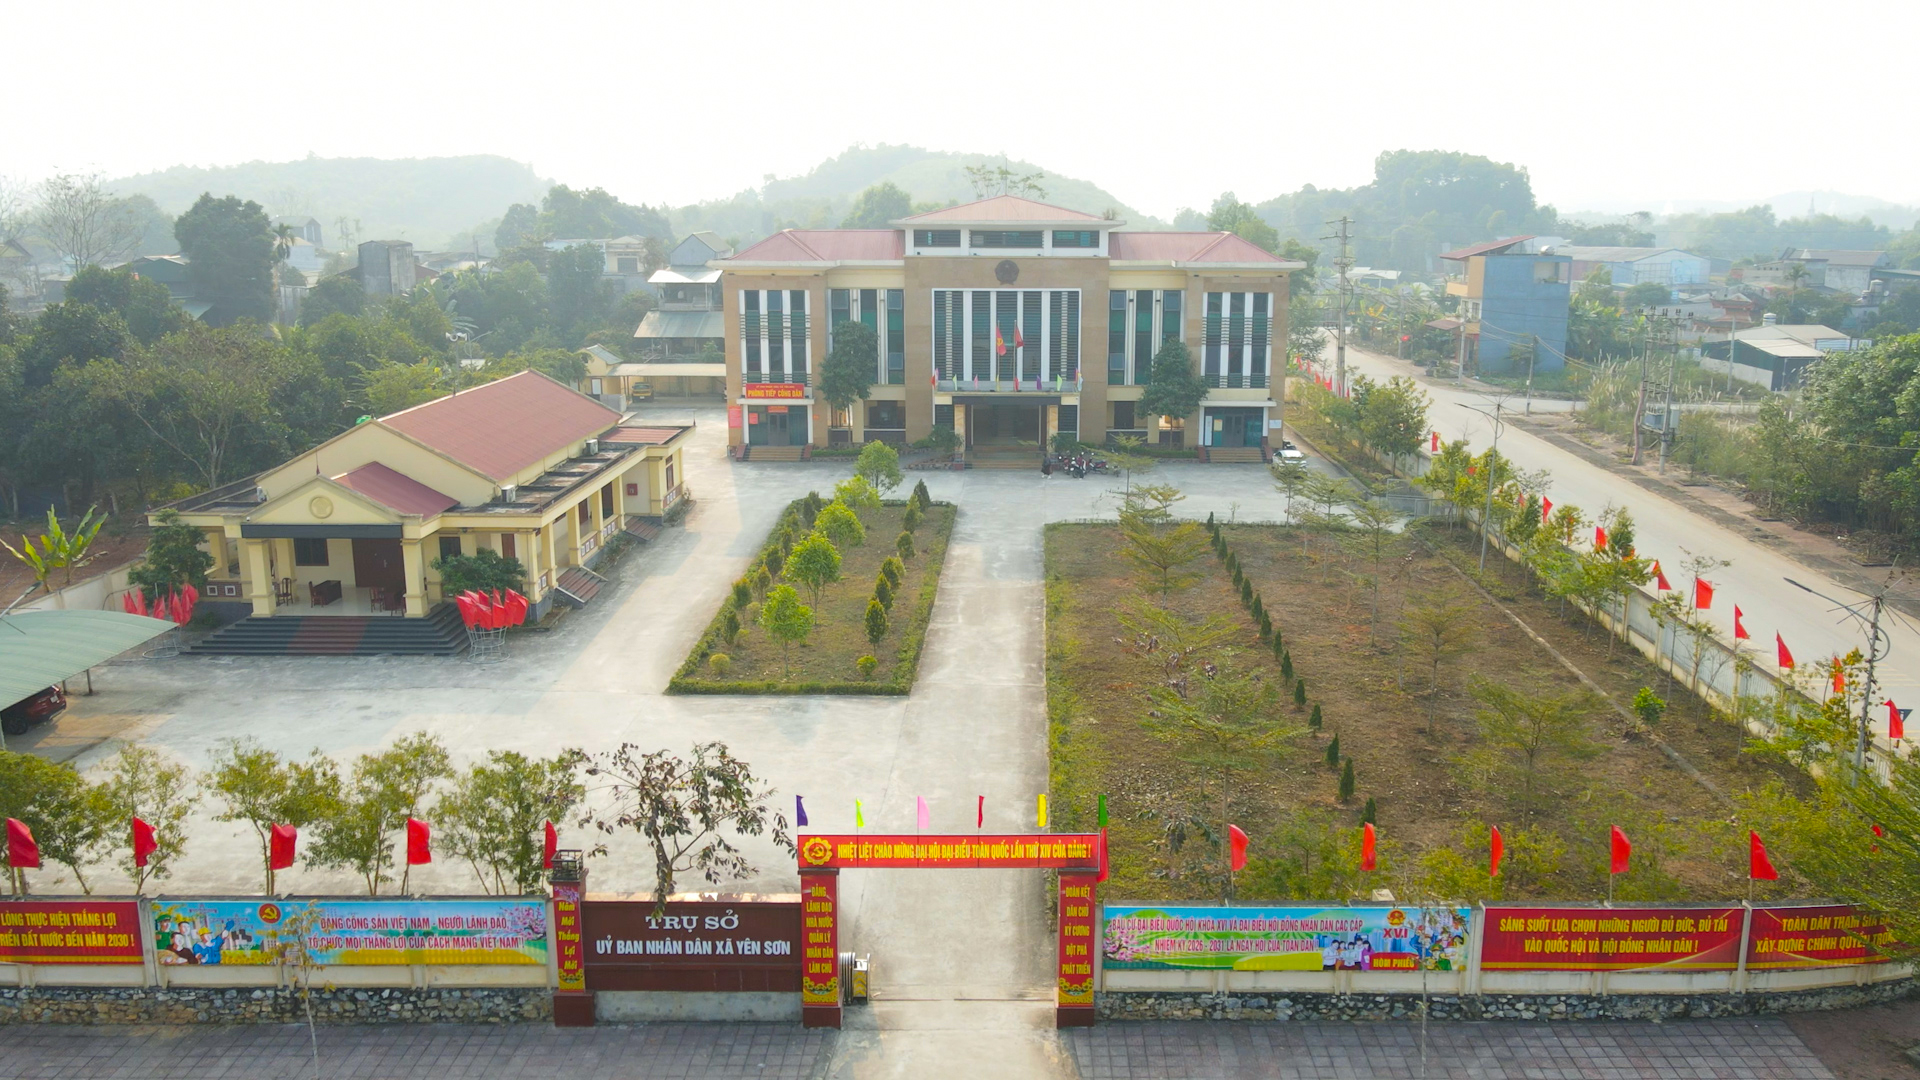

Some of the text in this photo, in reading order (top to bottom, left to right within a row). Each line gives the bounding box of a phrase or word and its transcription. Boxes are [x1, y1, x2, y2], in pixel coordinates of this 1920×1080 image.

[838, 841, 857, 861] NHIỆT
[858, 841, 872, 861] LIỆT
[874, 842, 892, 858] CHÀO
[893, 842, 914, 858] MỪNG
[916, 844, 927, 862] ĐẠI
[929, 841, 940, 862] HỘI
[942, 844, 953, 862] ĐẠI
[955, 839, 970, 858] BIỂU
[972, 841, 990, 858] TOÀN
[991, 839, 1010, 860] QUỐC
[1025, 841, 1039, 858] THỨ
[1040, 844, 1051, 858] XIV
[1052, 839, 1066, 858] CỦA
[1068, 839, 1087, 858] ĐẢNG
[811, 883, 826, 897] ĐẢNG
[558, 902, 575, 911] Năm
[0, 909, 116, 929] LÒNG THỰC HIỆN THẮNG LỢI
[321, 914, 343, 929] ĐẢNG
[345, 914, 368, 932] CỘNG
[371, 914, 389, 929] SẢN
[391, 915, 407, 932] VIỆT
[410, 917, 430, 929] NAM
[438, 915, 464, 929] NGƯỜI
[466, 914, 488, 929] LÃNH
[561, 916, 575, 926] Mới
[645, 909, 739, 933] TRỤ SỞ
[1150, 914, 1164, 931] BIỂU
[1166, 915, 1183, 931] QUỐC
[1252, 914, 1266, 931] BIỂU
[1269, 916, 1278, 934] HỘI
[1281, 915, 1298, 931] ĐỒNG
[1301, 917, 1318, 931] NHÂN
[1320, 917, 1333, 931] DÂN
[1500, 914, 1728, 935] SÁNG SUỐT LỰA CHỌN NHỮNG NGƯỜI ĐỦ ĐỨC, ĐỦ TÀI
[1782, 916, 1808, 931] TOÀN
[1810, 915, 1831, 930] DÂN
[21, 929, 38, 947] ĐẤT
[40, 931, 64, 947] NƯỚC
[66, 930, 84, 947] ĐẾN
[85, 931, 106, 947] NĂM
[107, 934, 129, 947] 2030
[131, 934, 135, 947] !
[308, 933, 318, 948] TỔ
[320, 934, 343, 948] CHỨC
[345, 937, 362, 951] MỌI
[364, 932, 391, 948] THẮNG
[394, 936, 406, 951] LỢI
[409, 932, 426, 948] CỦA
[428, 934, 450, 948] CÁCH
[453, 937, 477, 951] MẠNG
[480, 934, 496, 951] VIỆT
[500, 937, 519, 948] NAM
[558, 929, 580, 942] Thắng
[1383, 928, 1408, 938] XVI
[565, 946, 575, 957] Lợi
[616, 940, 643, 954] BAN
[646, 937, 682, 955] NHÂN
[685, 937, 712, 955] DÂN
[716, 938, 734, 955] XÃ
[736, 937, 760, 955] YÊN
[764, 940, 790, 955] SƠN
[1188, 940, 1203, 951] 2026
[1210, 940, 1224, 951] 2031
[1525, 935, 1698, 956] VÀO QUỐC HỘI VÀ HỘI ĐỒNG NHÂN DÂN !
[1756, 938, 1775, 953] XÂY
[1778, 938, 1805, 953] DỰNG
[1807, 935, 1837, 951] CHÍNH
[564, 960, 577, 970] Mới
[1373, 958, 1391, 968] HÒM
